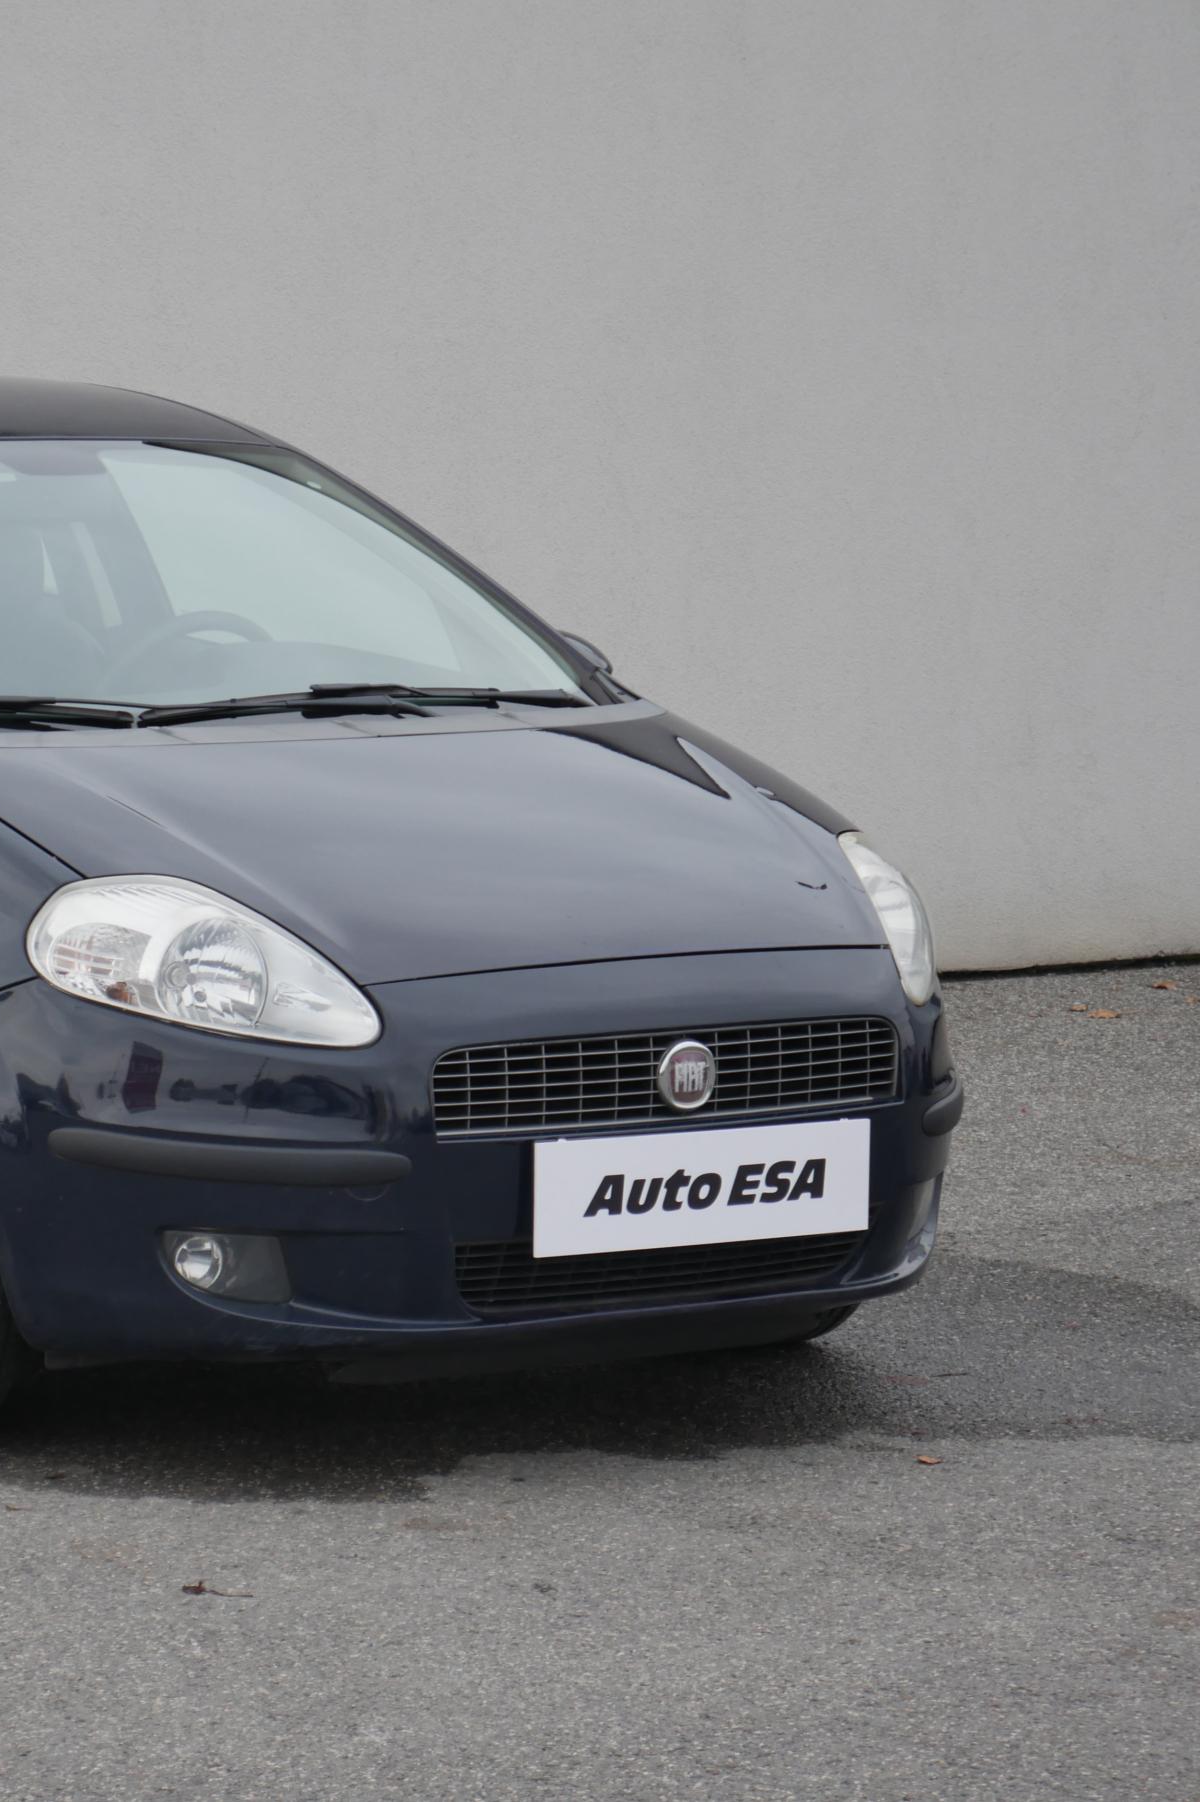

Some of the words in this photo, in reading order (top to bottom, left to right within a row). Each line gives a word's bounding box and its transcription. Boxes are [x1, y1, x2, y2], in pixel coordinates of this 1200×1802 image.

[674, 1061, 706, 1093] FIAT
[583, 1169, 722, 1218] Auto
[726, 1158, 827, 1206] ESA
